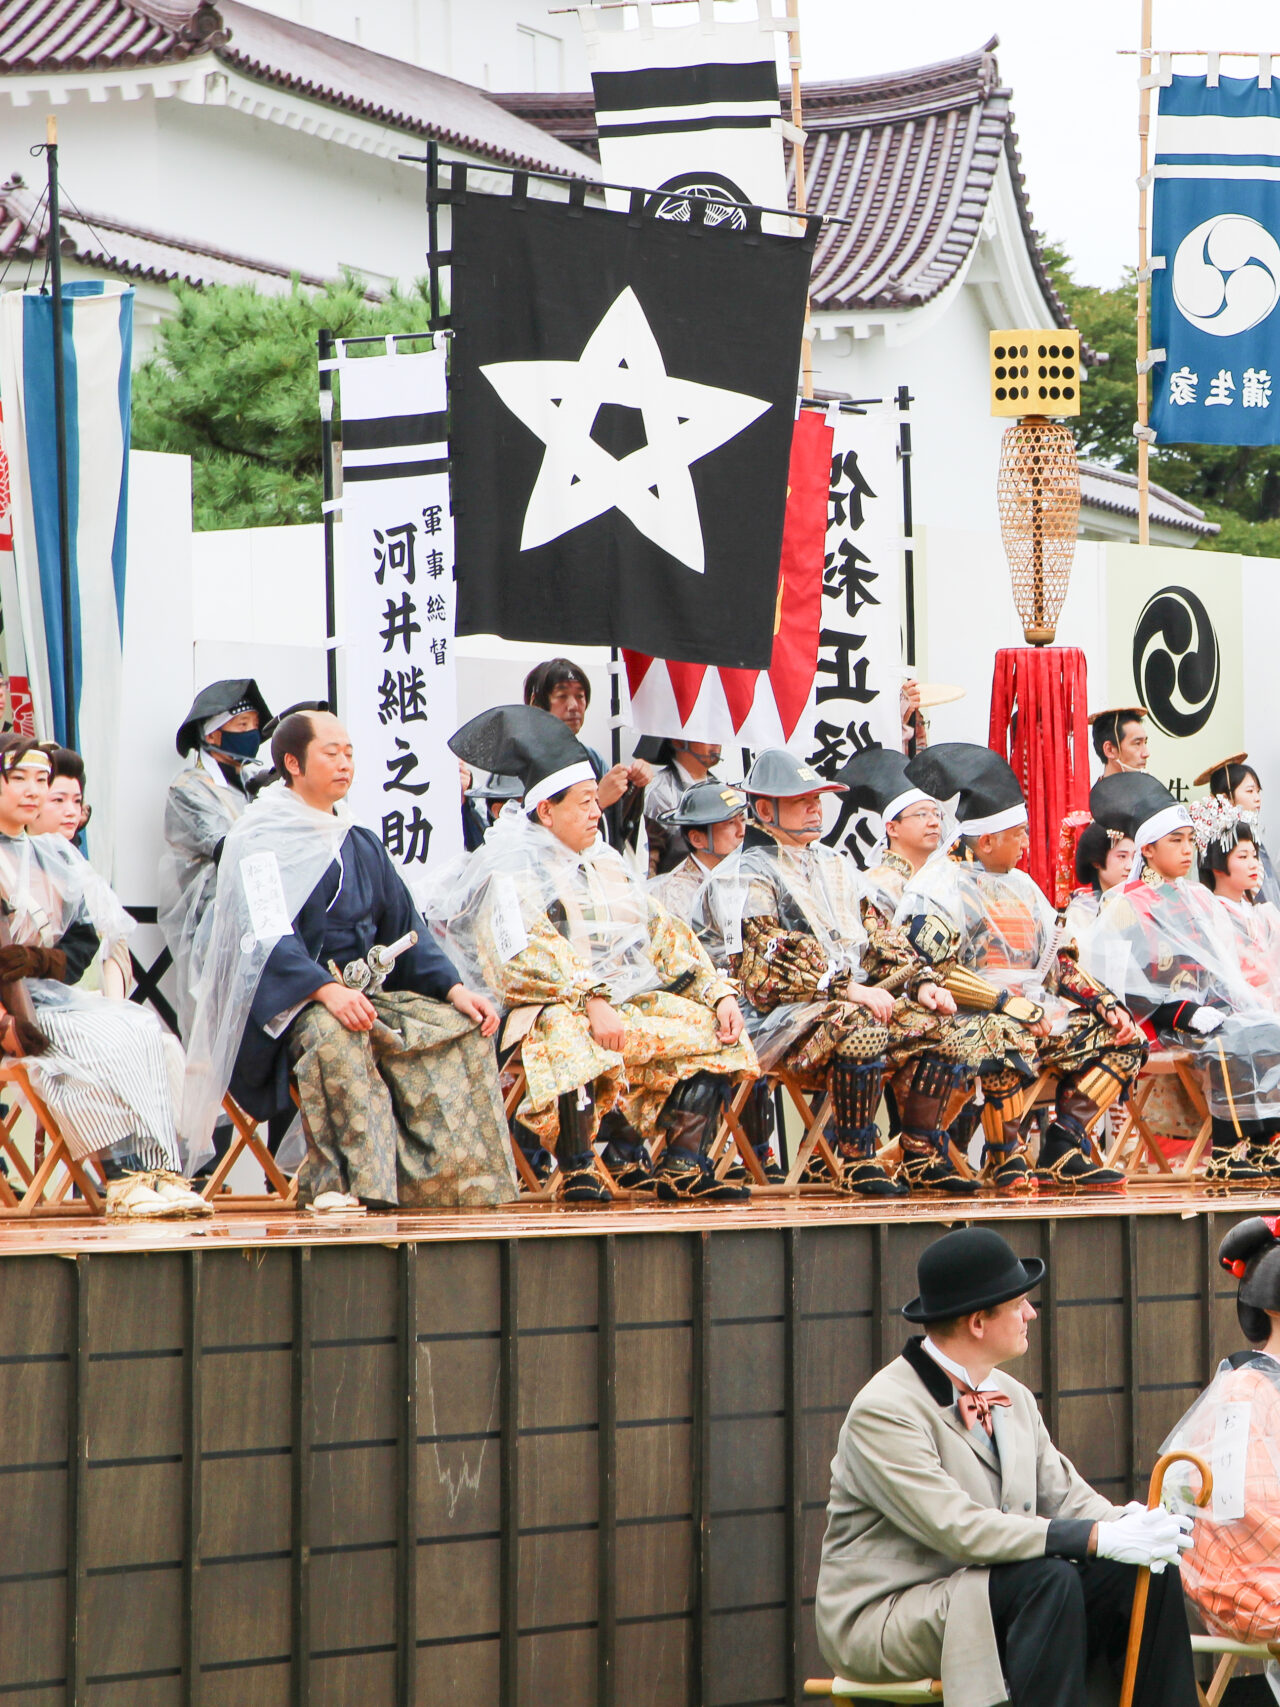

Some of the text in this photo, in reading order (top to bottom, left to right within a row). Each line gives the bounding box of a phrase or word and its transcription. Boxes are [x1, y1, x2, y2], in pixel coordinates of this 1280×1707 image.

[422, 505, 446, 665] 軍事総督
[373, 522, 433, 864] 河井継之助
[1220, 1415, 1238, 1505] おけい
